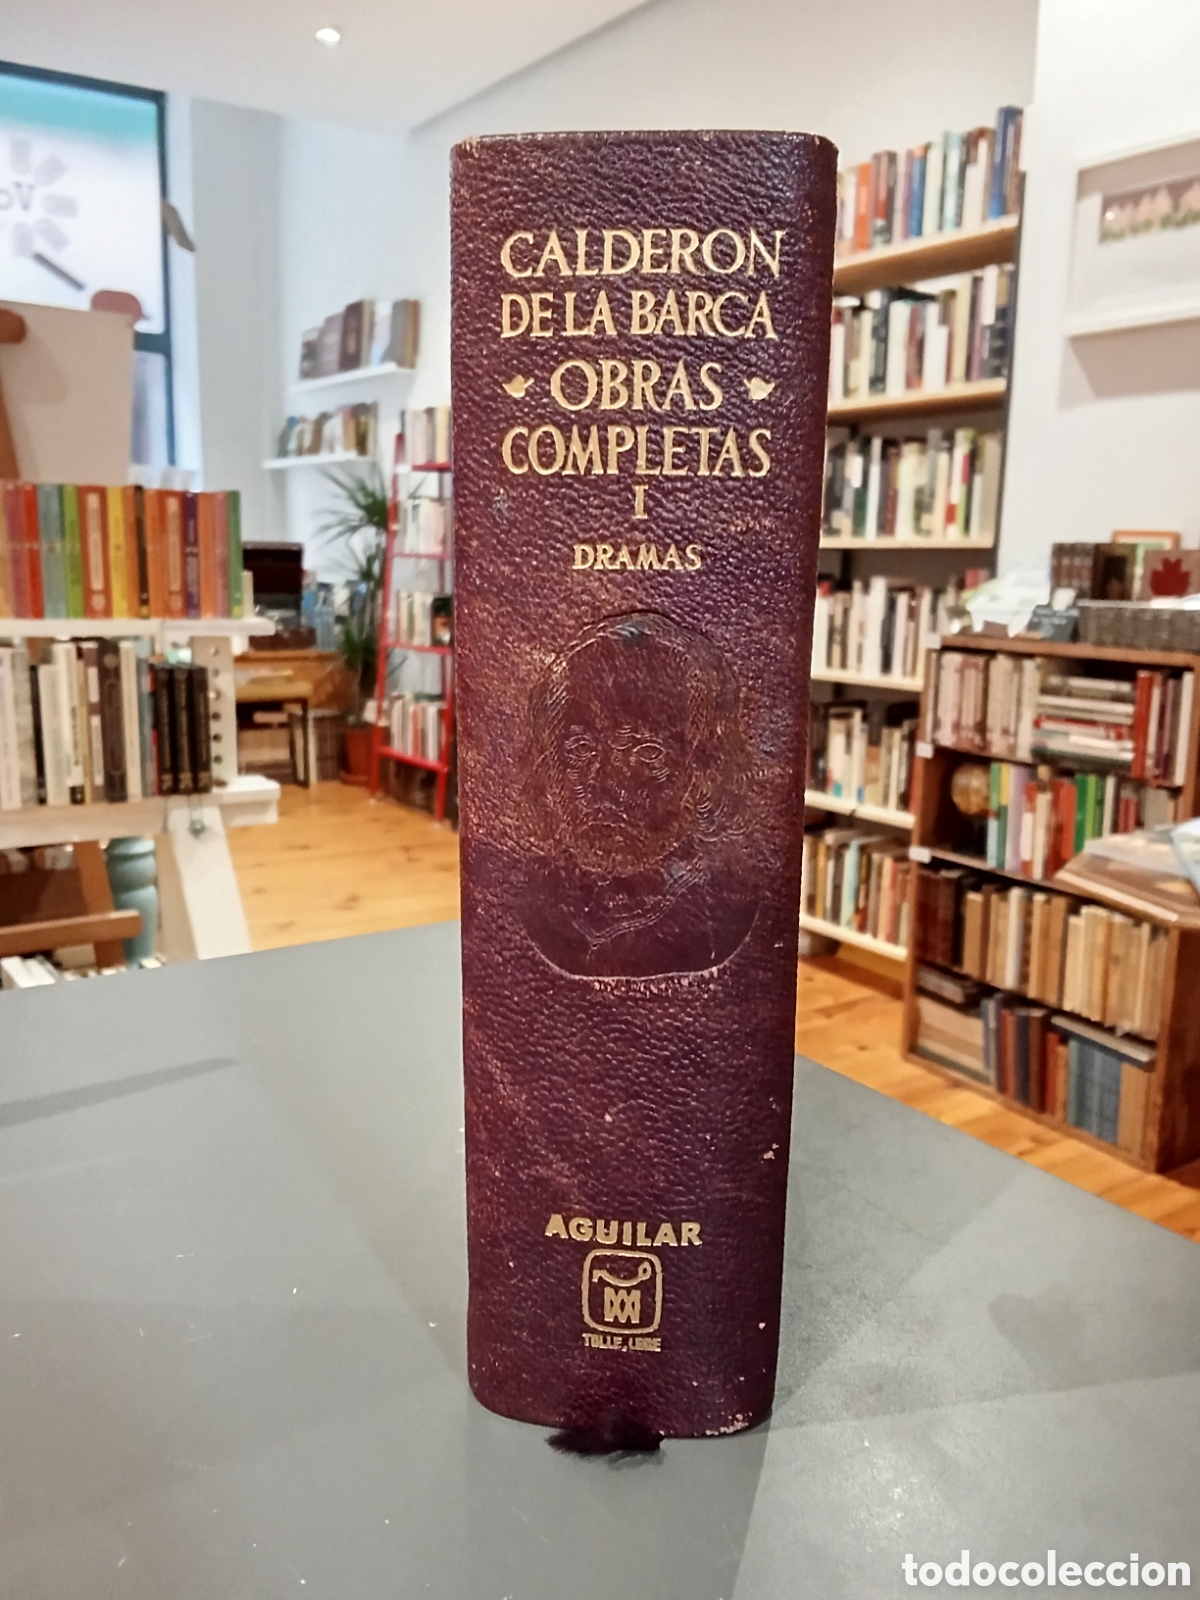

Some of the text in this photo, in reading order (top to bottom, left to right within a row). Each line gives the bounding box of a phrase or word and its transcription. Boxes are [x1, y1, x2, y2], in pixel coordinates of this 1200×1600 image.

[501, 229, 786, 278] CALDERON
[501, 290, 778, 339] DE LA BARCA
[551, 359, 723, 411] OBRAS
[502, 424, 771, 477] COMPLETAS
[633, 484, 649, 519] I
[572, 544, 702, 570] DRAMAS
[545, 1214, 702, 1246] AGUILAR
